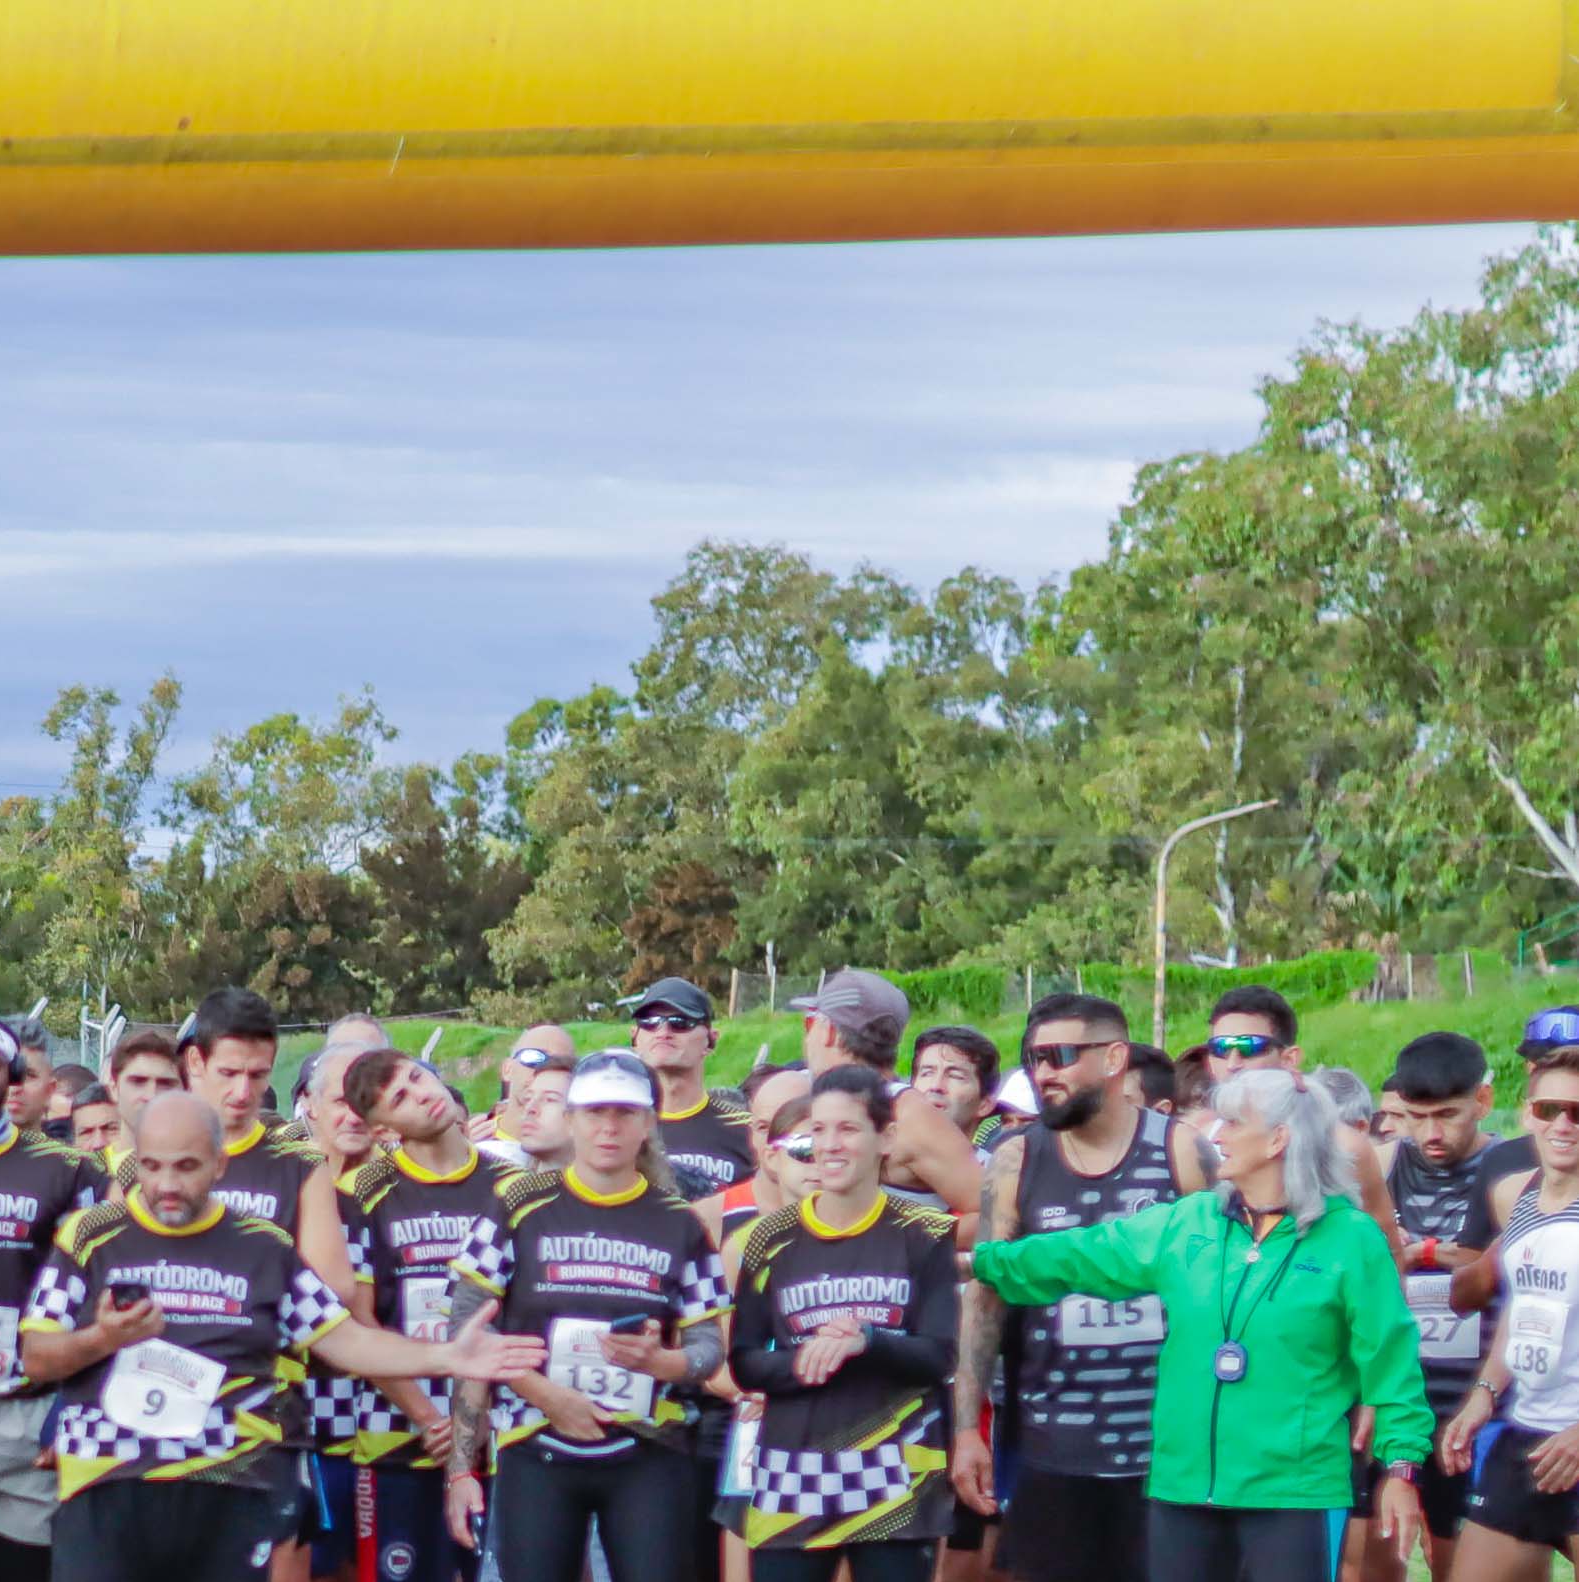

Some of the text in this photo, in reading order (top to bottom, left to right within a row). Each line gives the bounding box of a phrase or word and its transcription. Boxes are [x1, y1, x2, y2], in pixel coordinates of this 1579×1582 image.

[391, 1211, 480, 1248] AUTÓDR
[540, 1231, 672, 1275] AUTÓDROMO
[560, 1265, 650, 1289] RUNNING RACE
[1515, 1263, 1568, 1292] ATENAS
[191, 1294, 227, 1313] RACE
[780, 1272, 910, 1315] AUTÓDROMO
[856, 1306, 892, 1324] RACE
[1078, 1301, 1145, 1328] 115
[1512, 1344, 1550, 1375] 138
[568, 1363, 633, 1400] 132
[142, 1388, 167, 1416] 9
